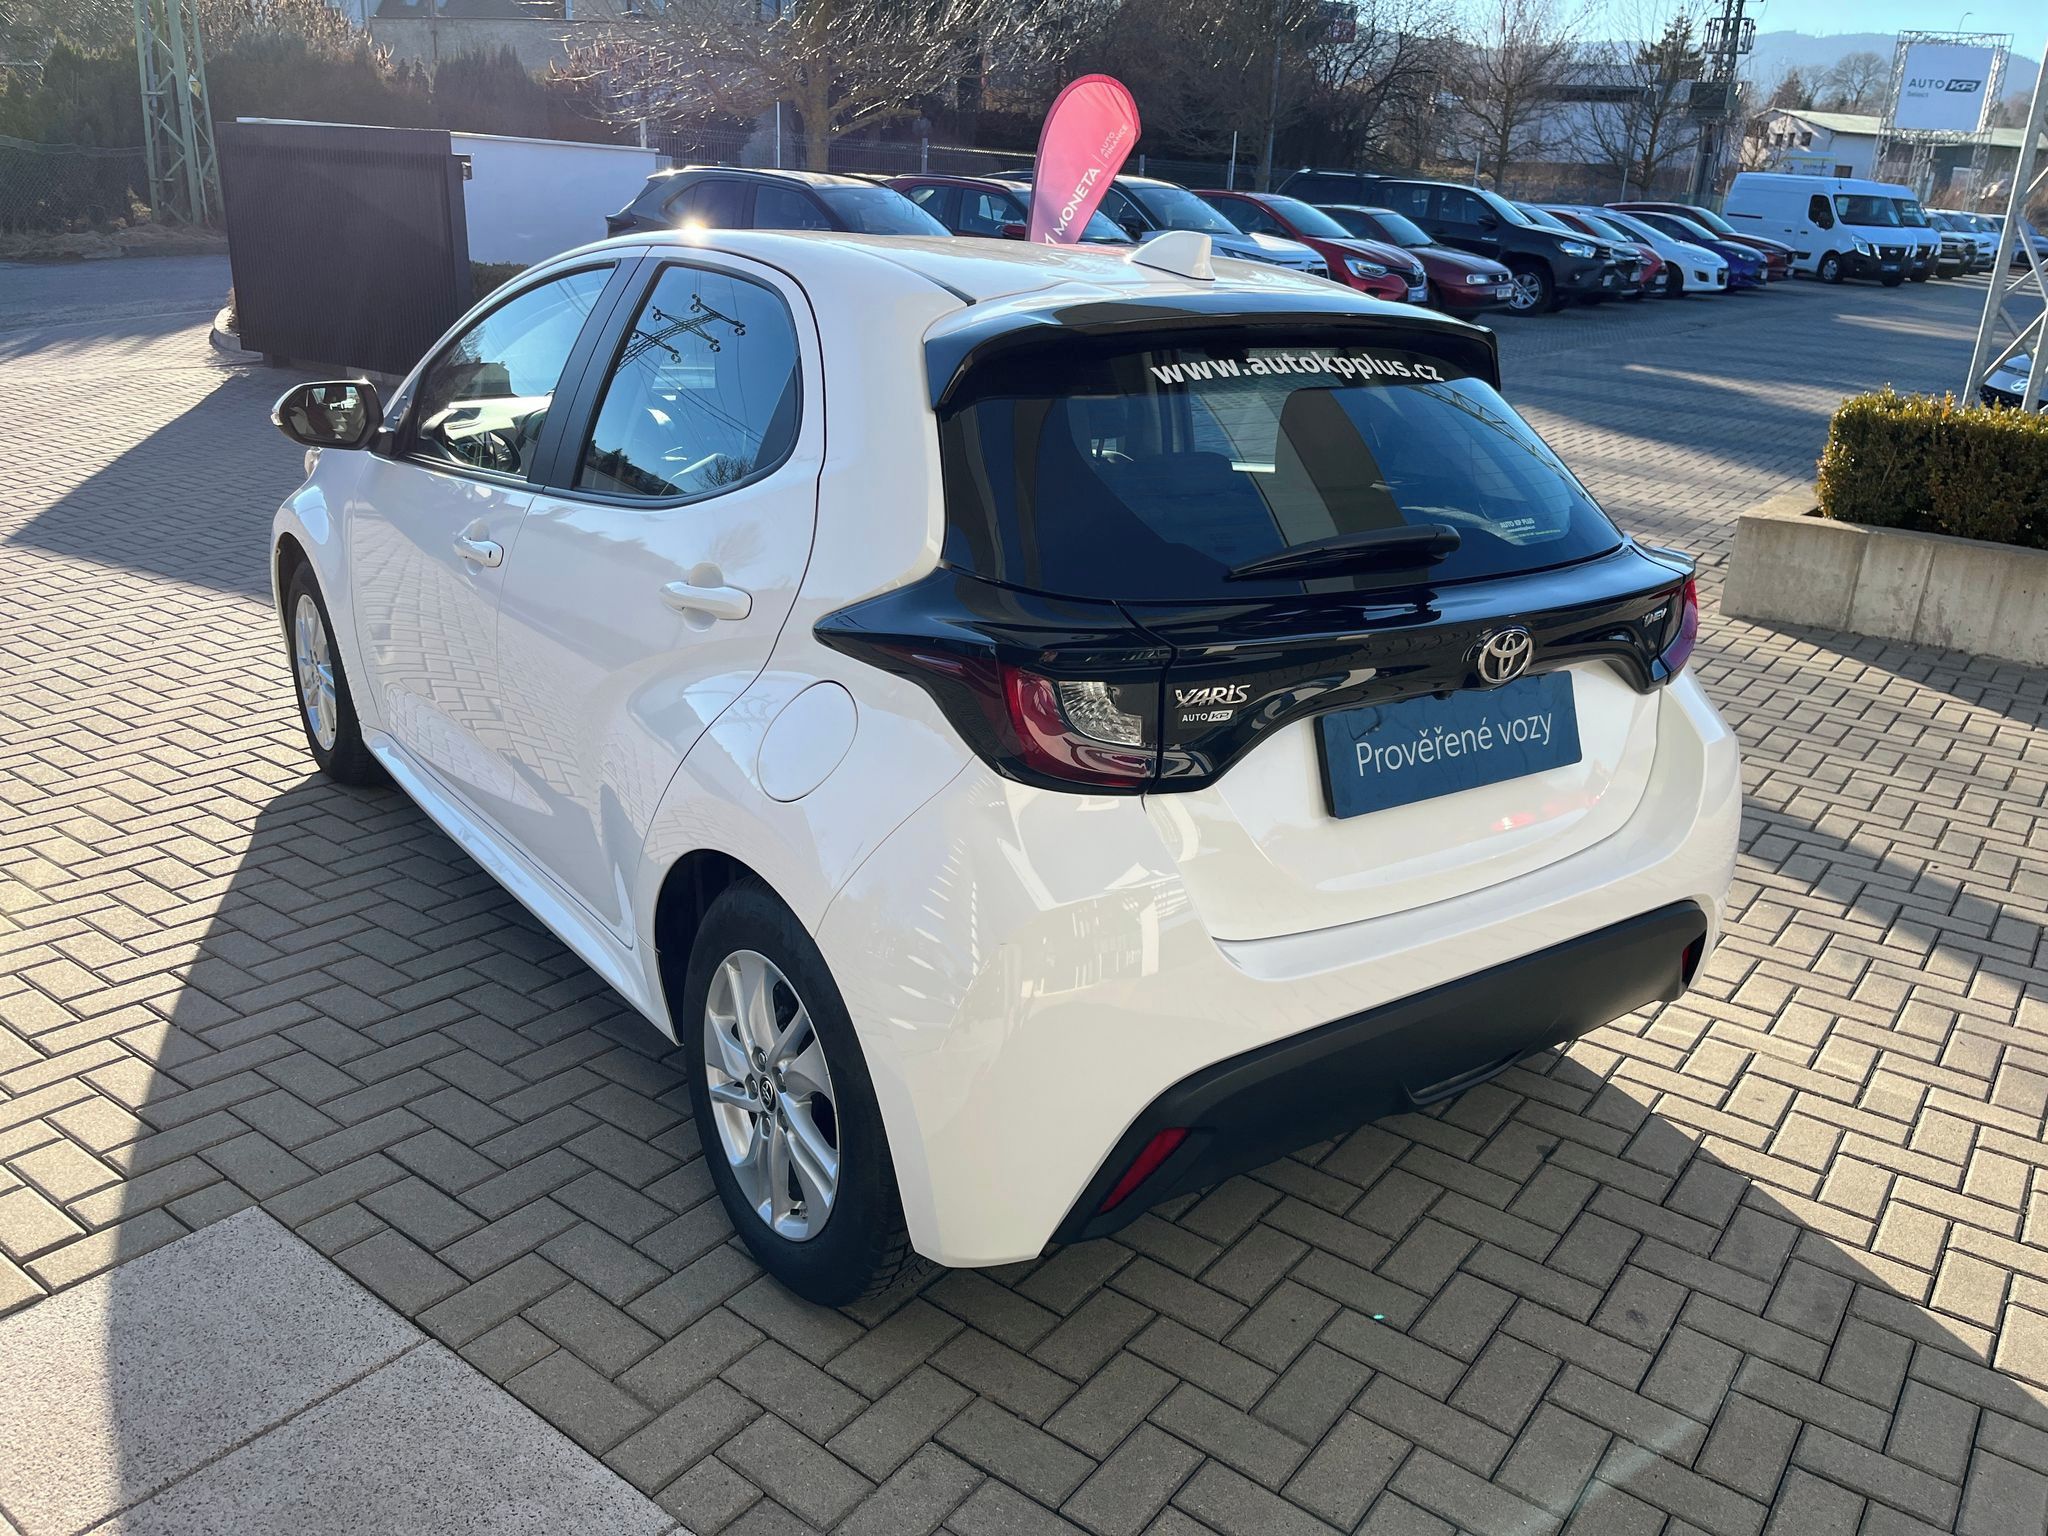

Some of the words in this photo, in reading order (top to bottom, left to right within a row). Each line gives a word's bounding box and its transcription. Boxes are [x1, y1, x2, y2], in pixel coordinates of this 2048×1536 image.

[1908, 78, 1945, 88] AUTO
[1100, 131, 1115, 154] AUTO
[1103, 124, 1128, 159] FINANCE
[1053, 167, 1101, 236] MONETA
[1150, 351, 1445, 385] www.autokpplus.cz
[1182, 713, 1208, 722] AUTO
[1355, 716, 1493, 777] Prověřené
[1497, 712, 1552, 746] vozy
